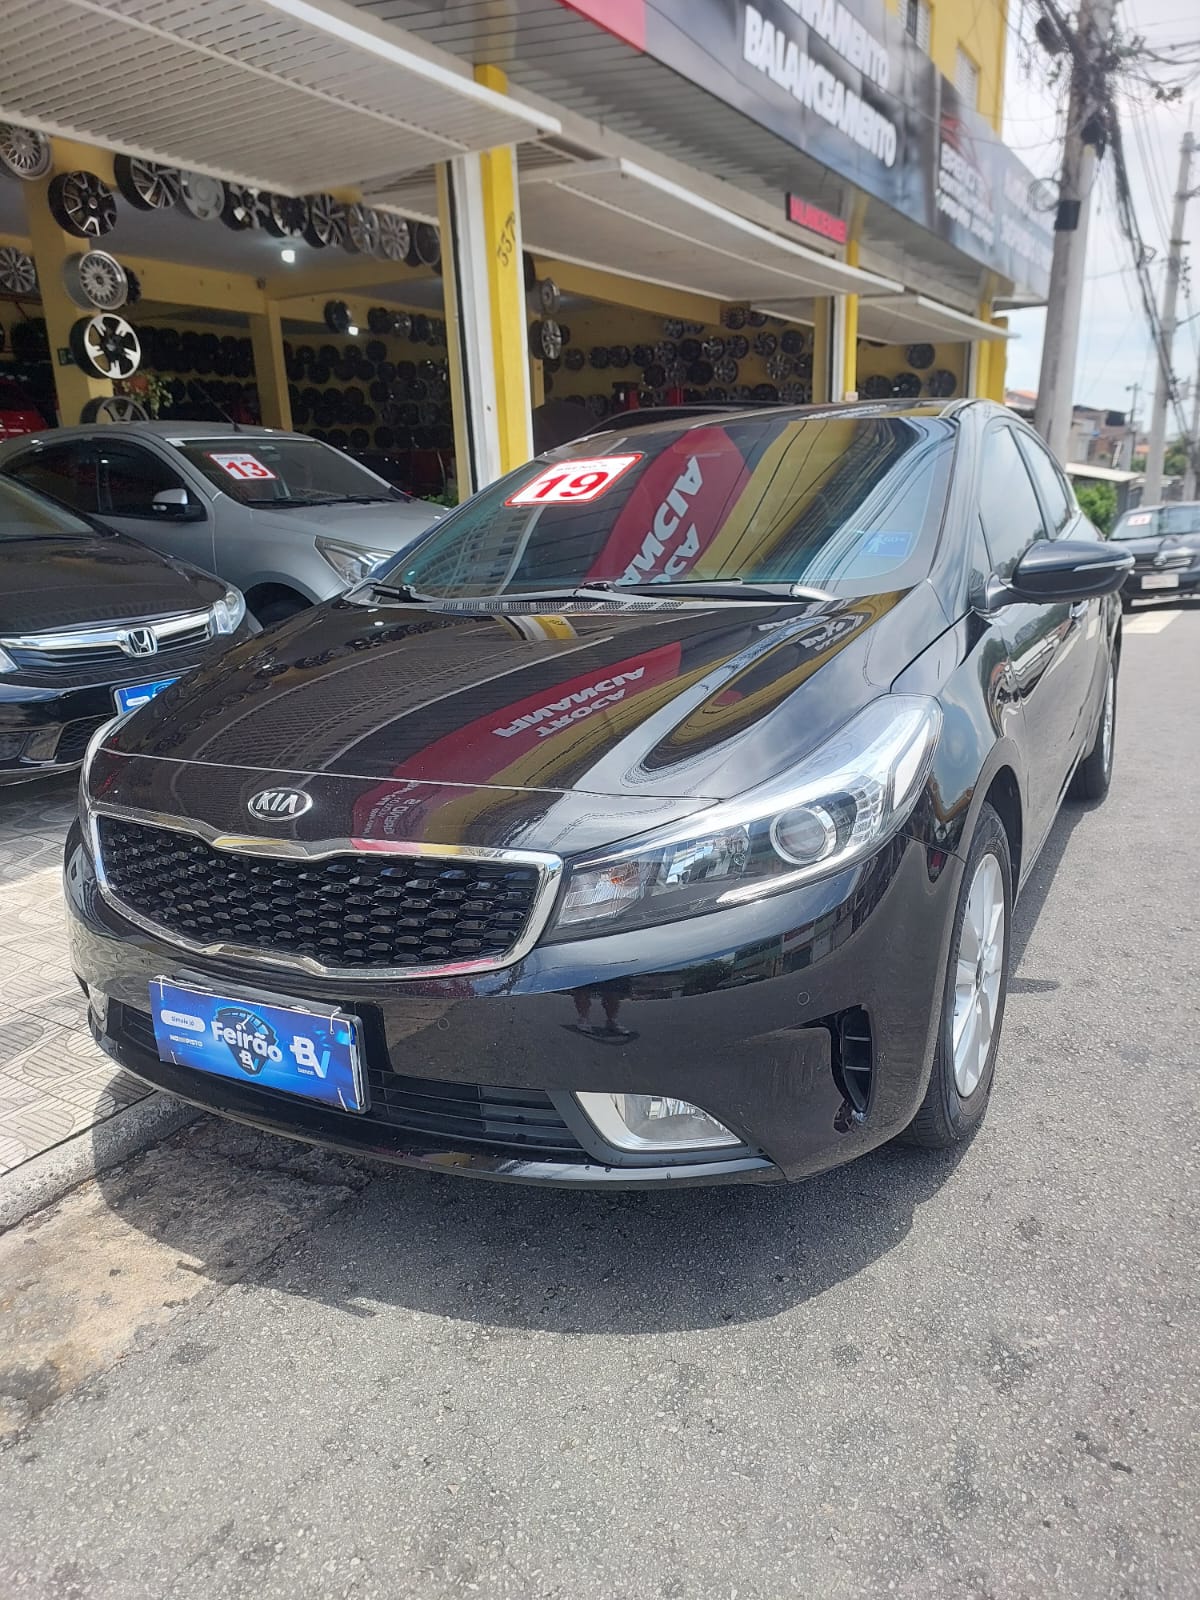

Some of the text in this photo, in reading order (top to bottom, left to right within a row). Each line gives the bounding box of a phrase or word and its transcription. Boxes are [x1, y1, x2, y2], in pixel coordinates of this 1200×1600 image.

[743, 5, 897, 168] BALANCEAMENTO
[226, 461, 269, 478] 13
[531, 471, 609, 499] 19
[255, 792, 299, 814] KIA
[211, 1020, 283, 1063] Feirão
[289, 1035, 331, 1079] BV
